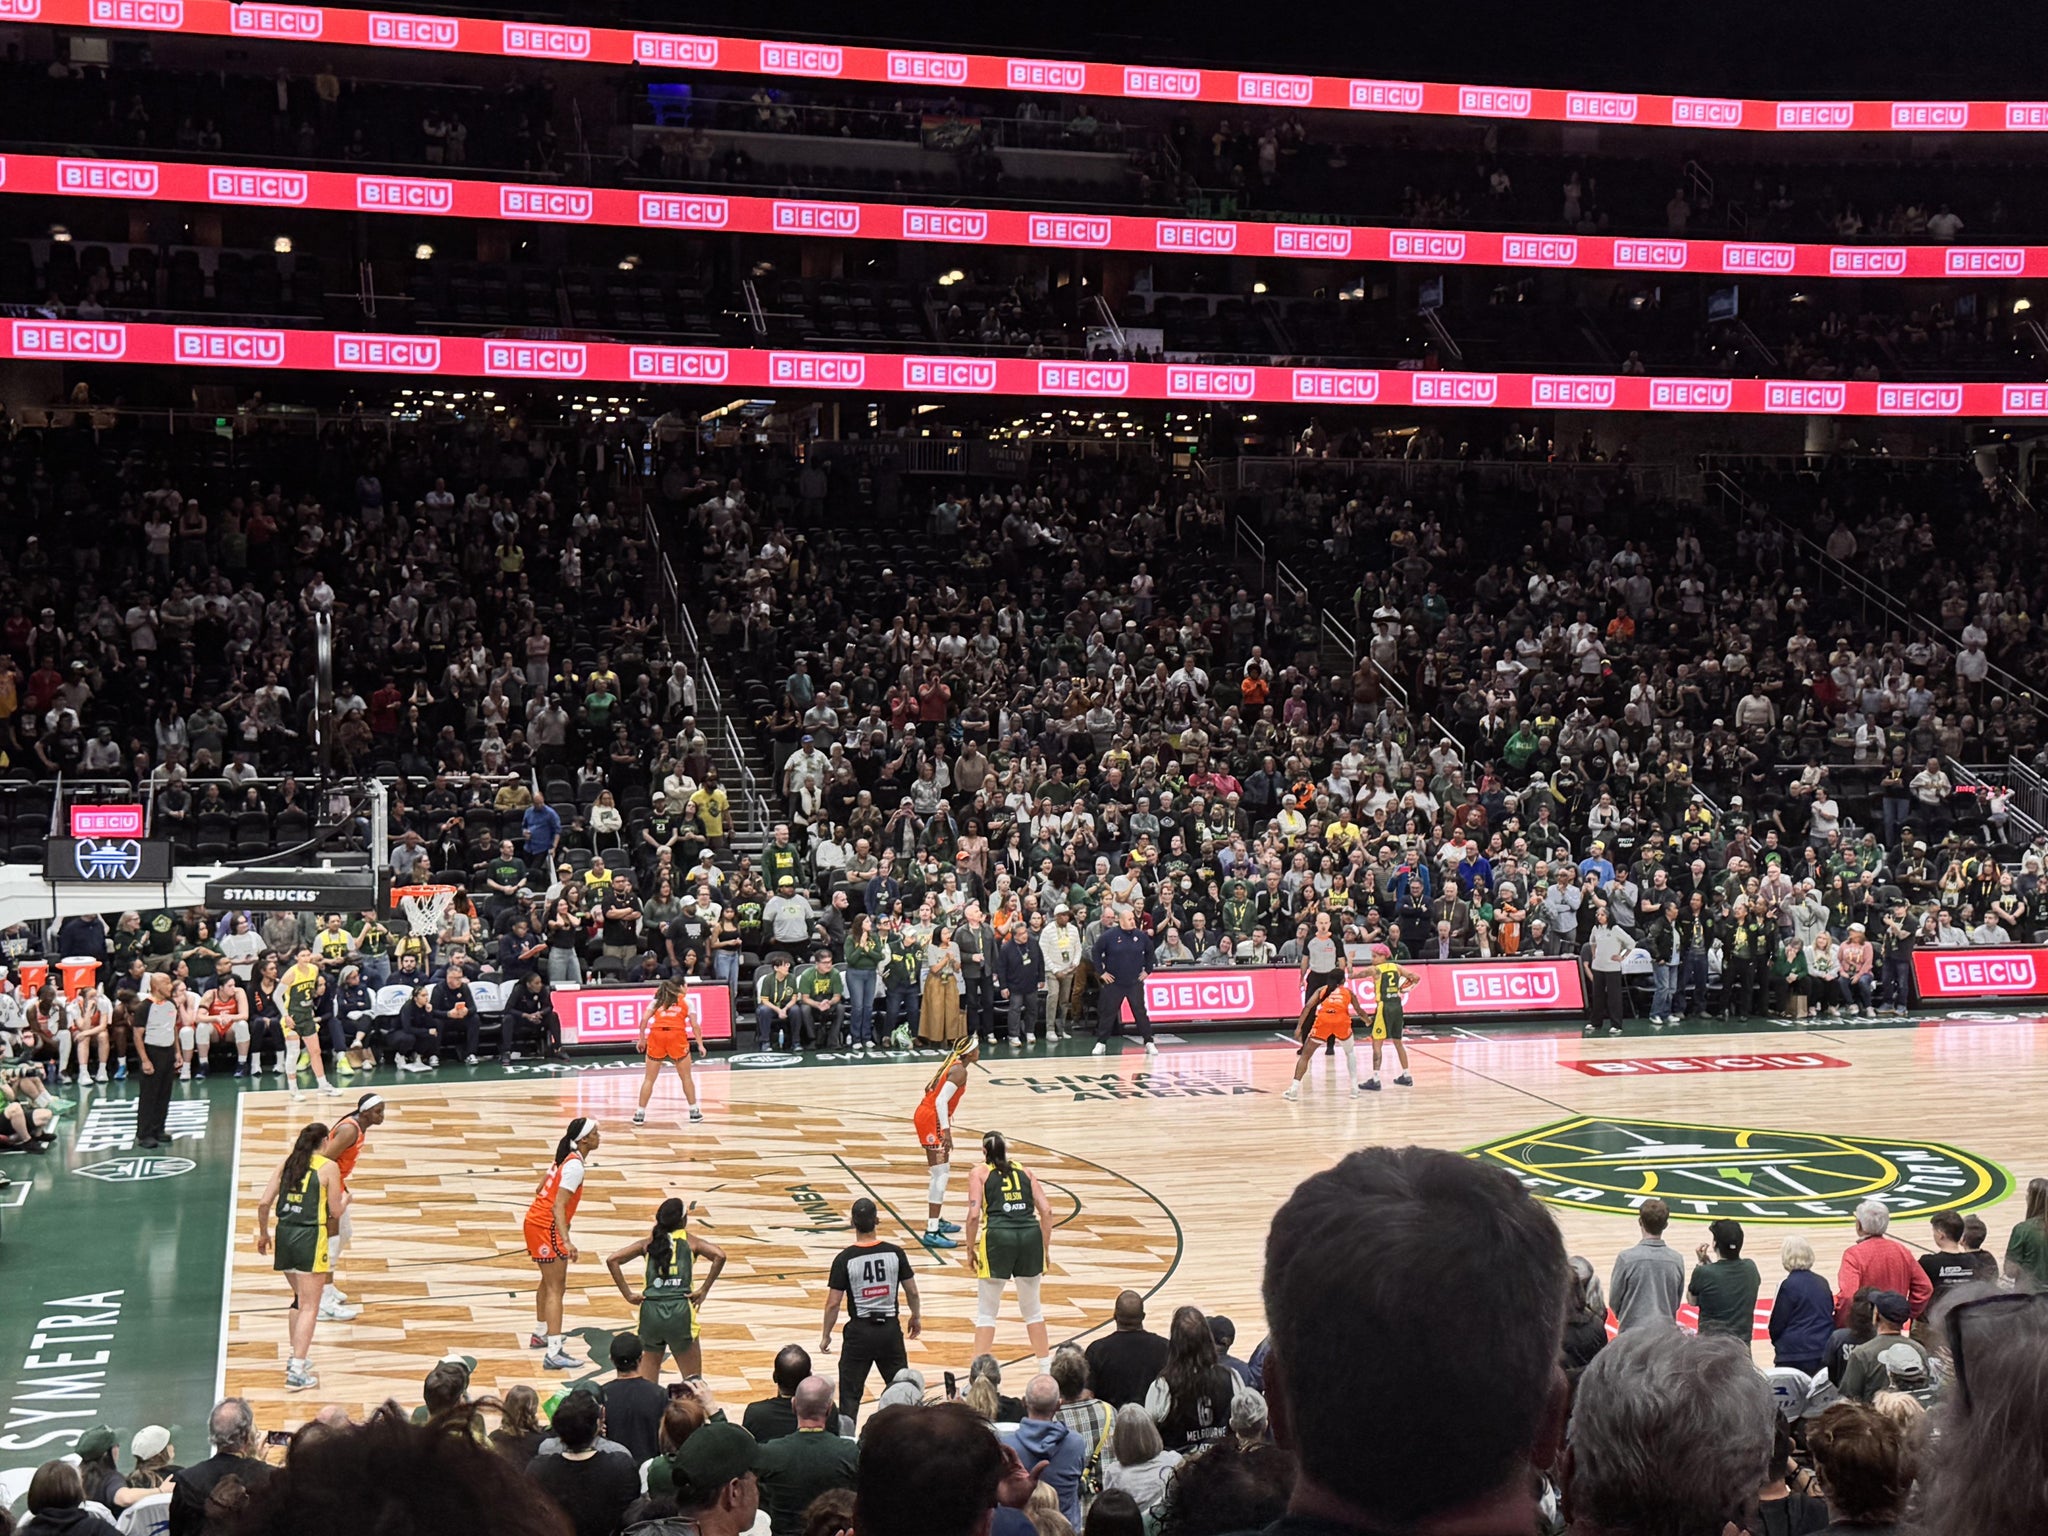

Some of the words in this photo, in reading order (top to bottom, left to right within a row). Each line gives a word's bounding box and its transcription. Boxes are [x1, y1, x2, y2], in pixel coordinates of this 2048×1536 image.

[96, 0, 177, 23] BECU
[238, 11, 317, 33] BECU
[376, 21, 452, 42] BECU
[511, 31, 584, 51] BECU
[641, 41, 712, 62] BECU
[767, 49, 836, 69] BECU
[894, 59, 961, 79] BECU
[1014, 66, 1080, 86] BECU
[1130, 73, 1195, 92] BECU
[1244, 80, 1308, 100] BECU
[1356, 86, 1418, 106] BECU
[1465, 93, 1526, 112] BECU
[1572, 98, 1632, 116] BECU
[1678, 104, 1737, 122] BECU
[1782, 108, 1849, 124] BECU
[1898, 108, 1964, 124] BECU
[2011, 107, 2048, 125] BE
[66, 167, 151, 188] BECU
[217, 176, 300, 197] BECU
[365, 185, 445, 205] BECU
[507, 193, 586, 213] BECU
[646, 201, 721, 220] BECU
[781, 208, 854, 228] BECU
[911, 215, 981, 235] BECU
[1035, 221, 1104, 239] BECU
[1163, 227, 1230, 245] BECU
[1280, 233, 1345, 251] BECU
[1396, 238, 1460, 254] BECU
[1509, 242, 1572, 258] BECU
[1620, 246, 1681, 262] BECU
[1729, 249, 1789, 266] BECU
[1836, 253, 1901, 269] BECU
[1952, 254, 2019, 269] BECU
[22, 330, 117, 352] BECU
[184, 335, 276, 358] BECU
[343, 341, 433, 364] BECU
[492, 348, 579, 370] BECU
[638, 354, 721, 375] BECU
[778, 359, 858, 381] BECU
[911, 365, 990, 386] BECU
[1045, 369, 1122, 389] BECU
[1174, 373, 1249, 393] BECU
[1300, 377, 1373, 397] BECU
[1419, 380, 1490, 399] BECU
[1539, 382, 1609, 402] BECU
[1657, 384, 1726, 404] BECU
[1771, 388, 1839, 407] BECU
[1884, 390, 1956, 408] BECU
[81, 817, 134, 828] BECU
[223, 888, 317, 902] STARBUCKS
[1387, 971, 1396, 987] 2
[1945, 963, 2028, 984] BECU
[1462, 975, 1552, 998] BECU
[1152, 983, 1247, 1012] BECU
[503, 1058, 721, 1074] Providee
[1588, 1055, 1823, 1073] BECU
[988, 1069, 1225, 1087] CLIMATE
[1027, 1079, 1250, 1094] PLEDGE
[1072, 1085, 1271, 1102] ARENA
[75, 1096, 140, 1153] SEATTLE
[1504, 1168, 1849, 1215] EATTLE
[1861, 1150, 1967, 1208] STORM
[785, 1183, 843, 1226] WNBA
[863, 1259, 886, 1283] 46
[664, 1278, 682, 1286] AT&T
[0, 1289, 125, 1451] SYMETRA
[1186, 1426, 1227, 1442] MELBOURNE
